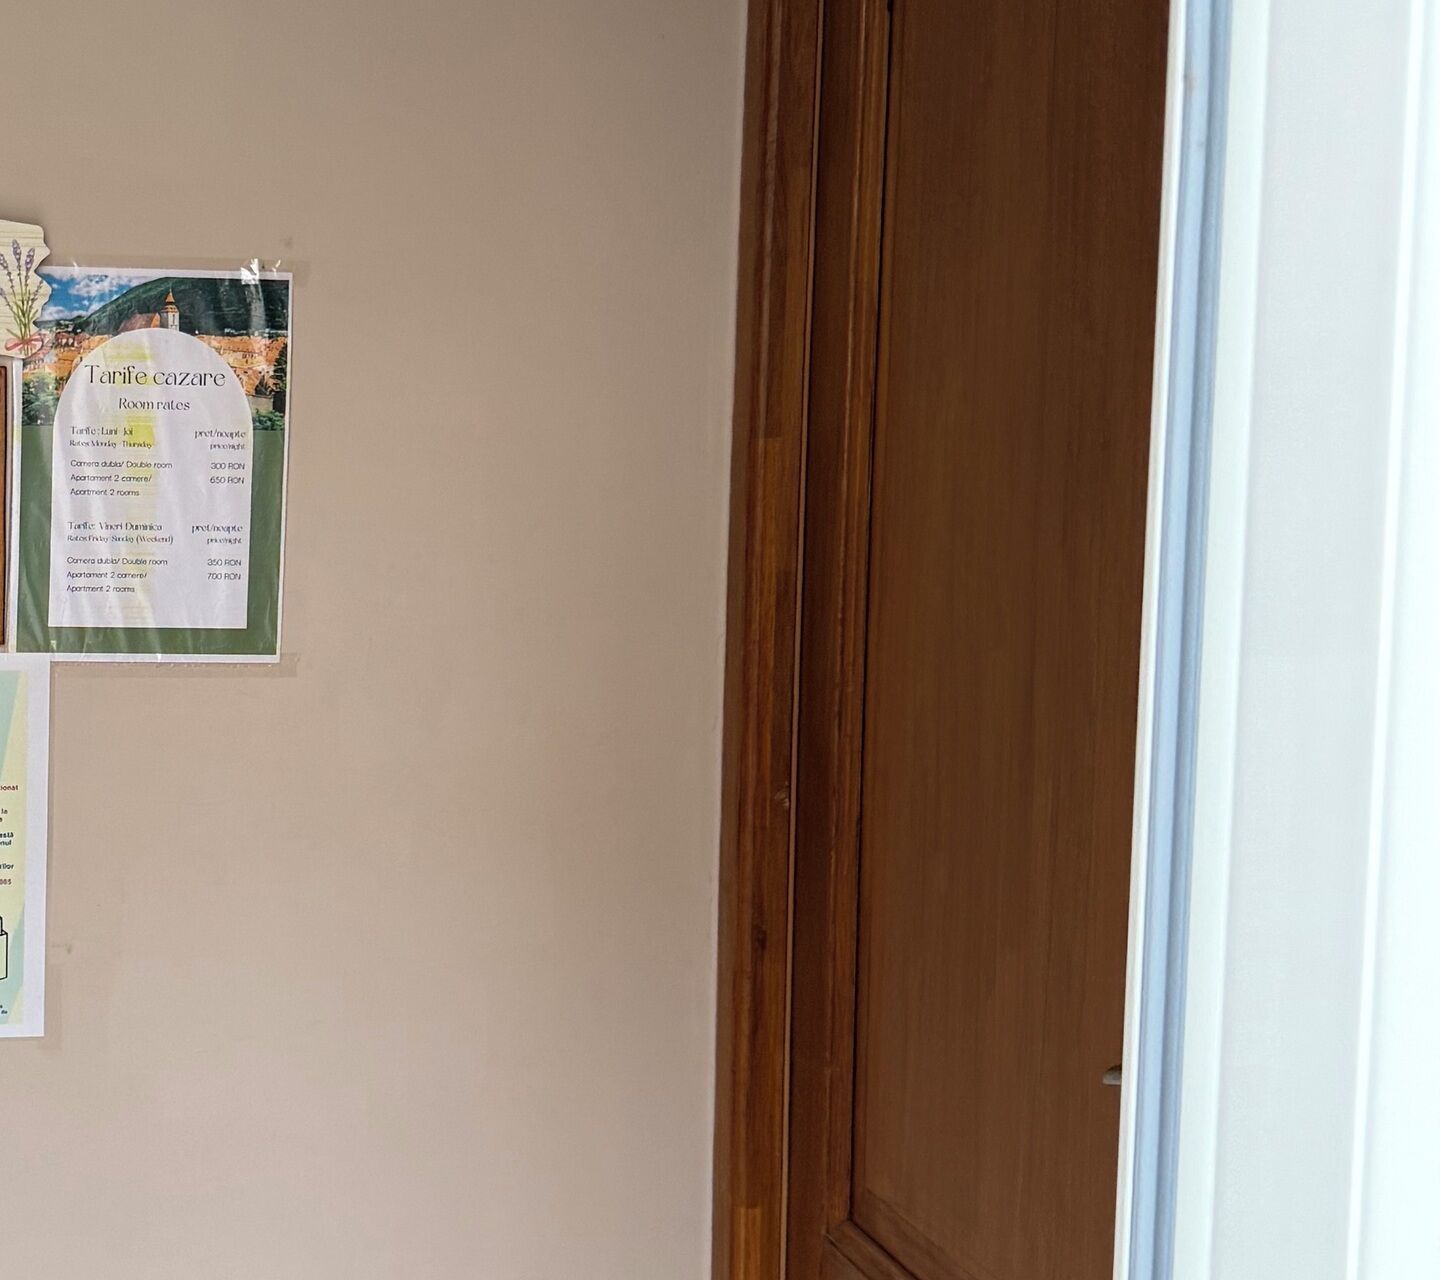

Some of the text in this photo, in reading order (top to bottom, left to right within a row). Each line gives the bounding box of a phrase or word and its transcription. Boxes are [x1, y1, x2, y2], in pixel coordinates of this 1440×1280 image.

[85, 364, 226, 386] Tarife cazare
[119, 398, 190, 410] Room rates
[71, 460, 100, 468] Camera
[211, 462, 226, 470] 300
[71, 474, 111, 483] Apartament
[210, 476, 225, 484] 650
[70, 488, 107, 497] Apartment
[67, 557, 95, 565] Camera
[67, 571, 107, 580] Apartament
[67, 585, 103, 594] Apartment
